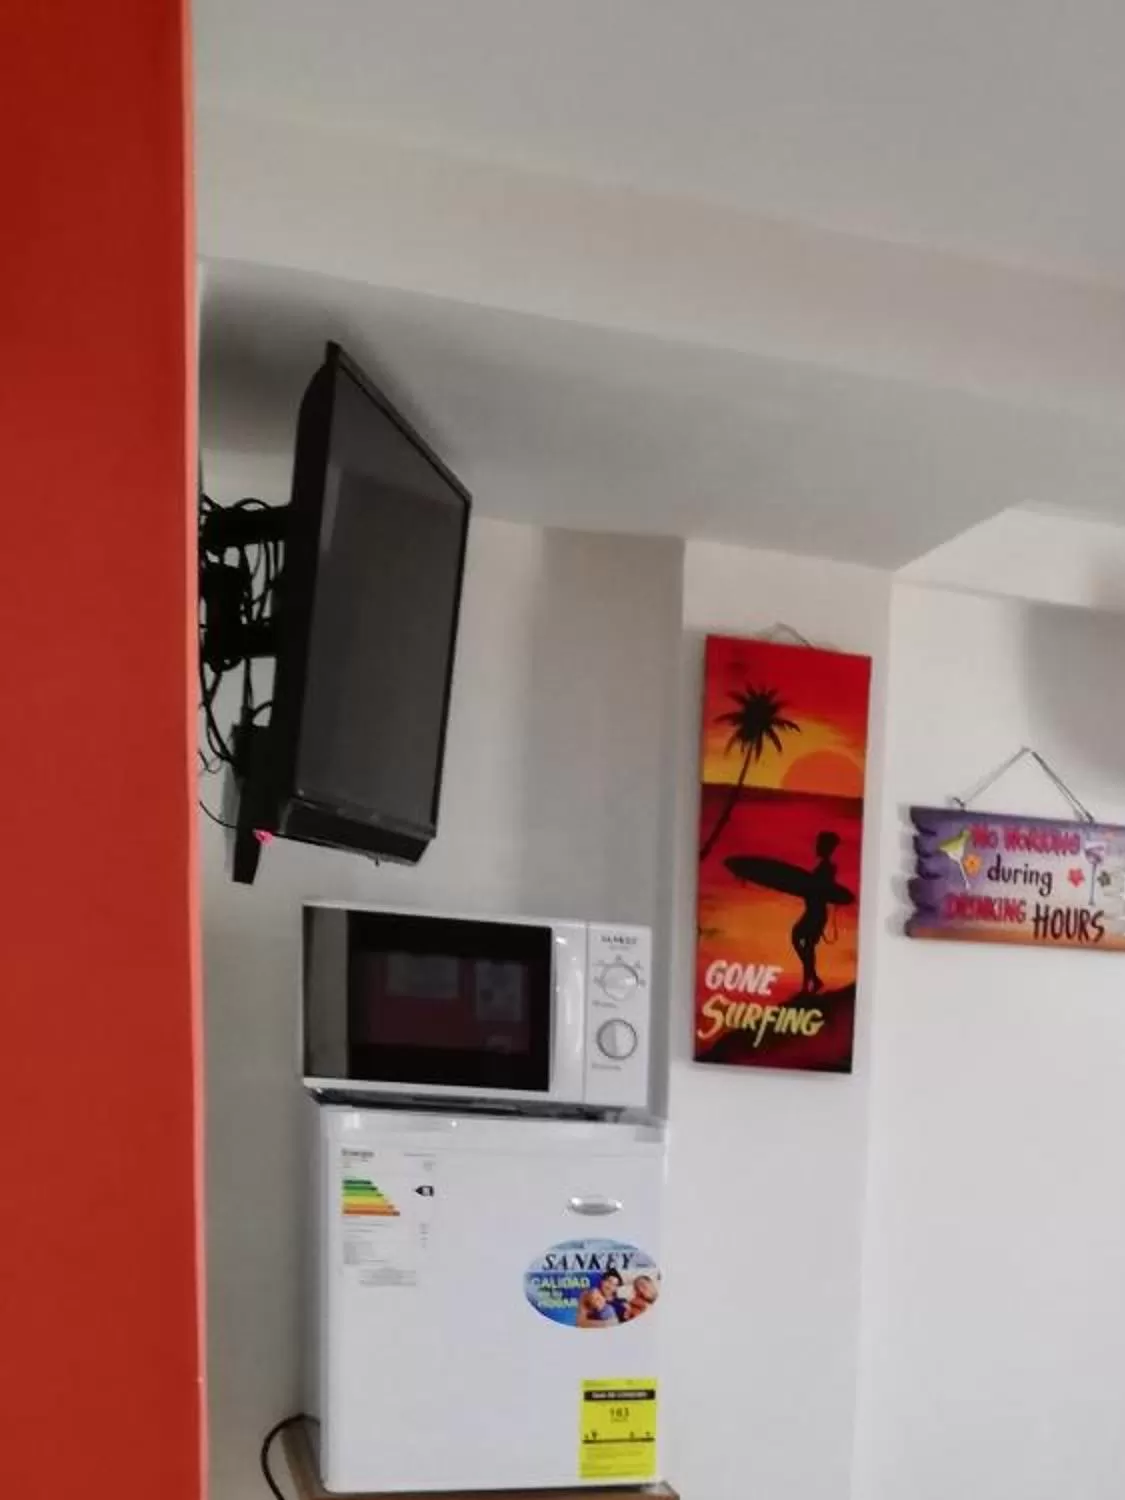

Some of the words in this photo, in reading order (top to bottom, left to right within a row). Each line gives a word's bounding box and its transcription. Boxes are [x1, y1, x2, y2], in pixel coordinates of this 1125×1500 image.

[987, 853, 1053, 896] during
[1032, 902, 1105, 943] HOURS
[705, 960, 783, 995] GONE
[541, 1251, 634, 1272] SANKEY
